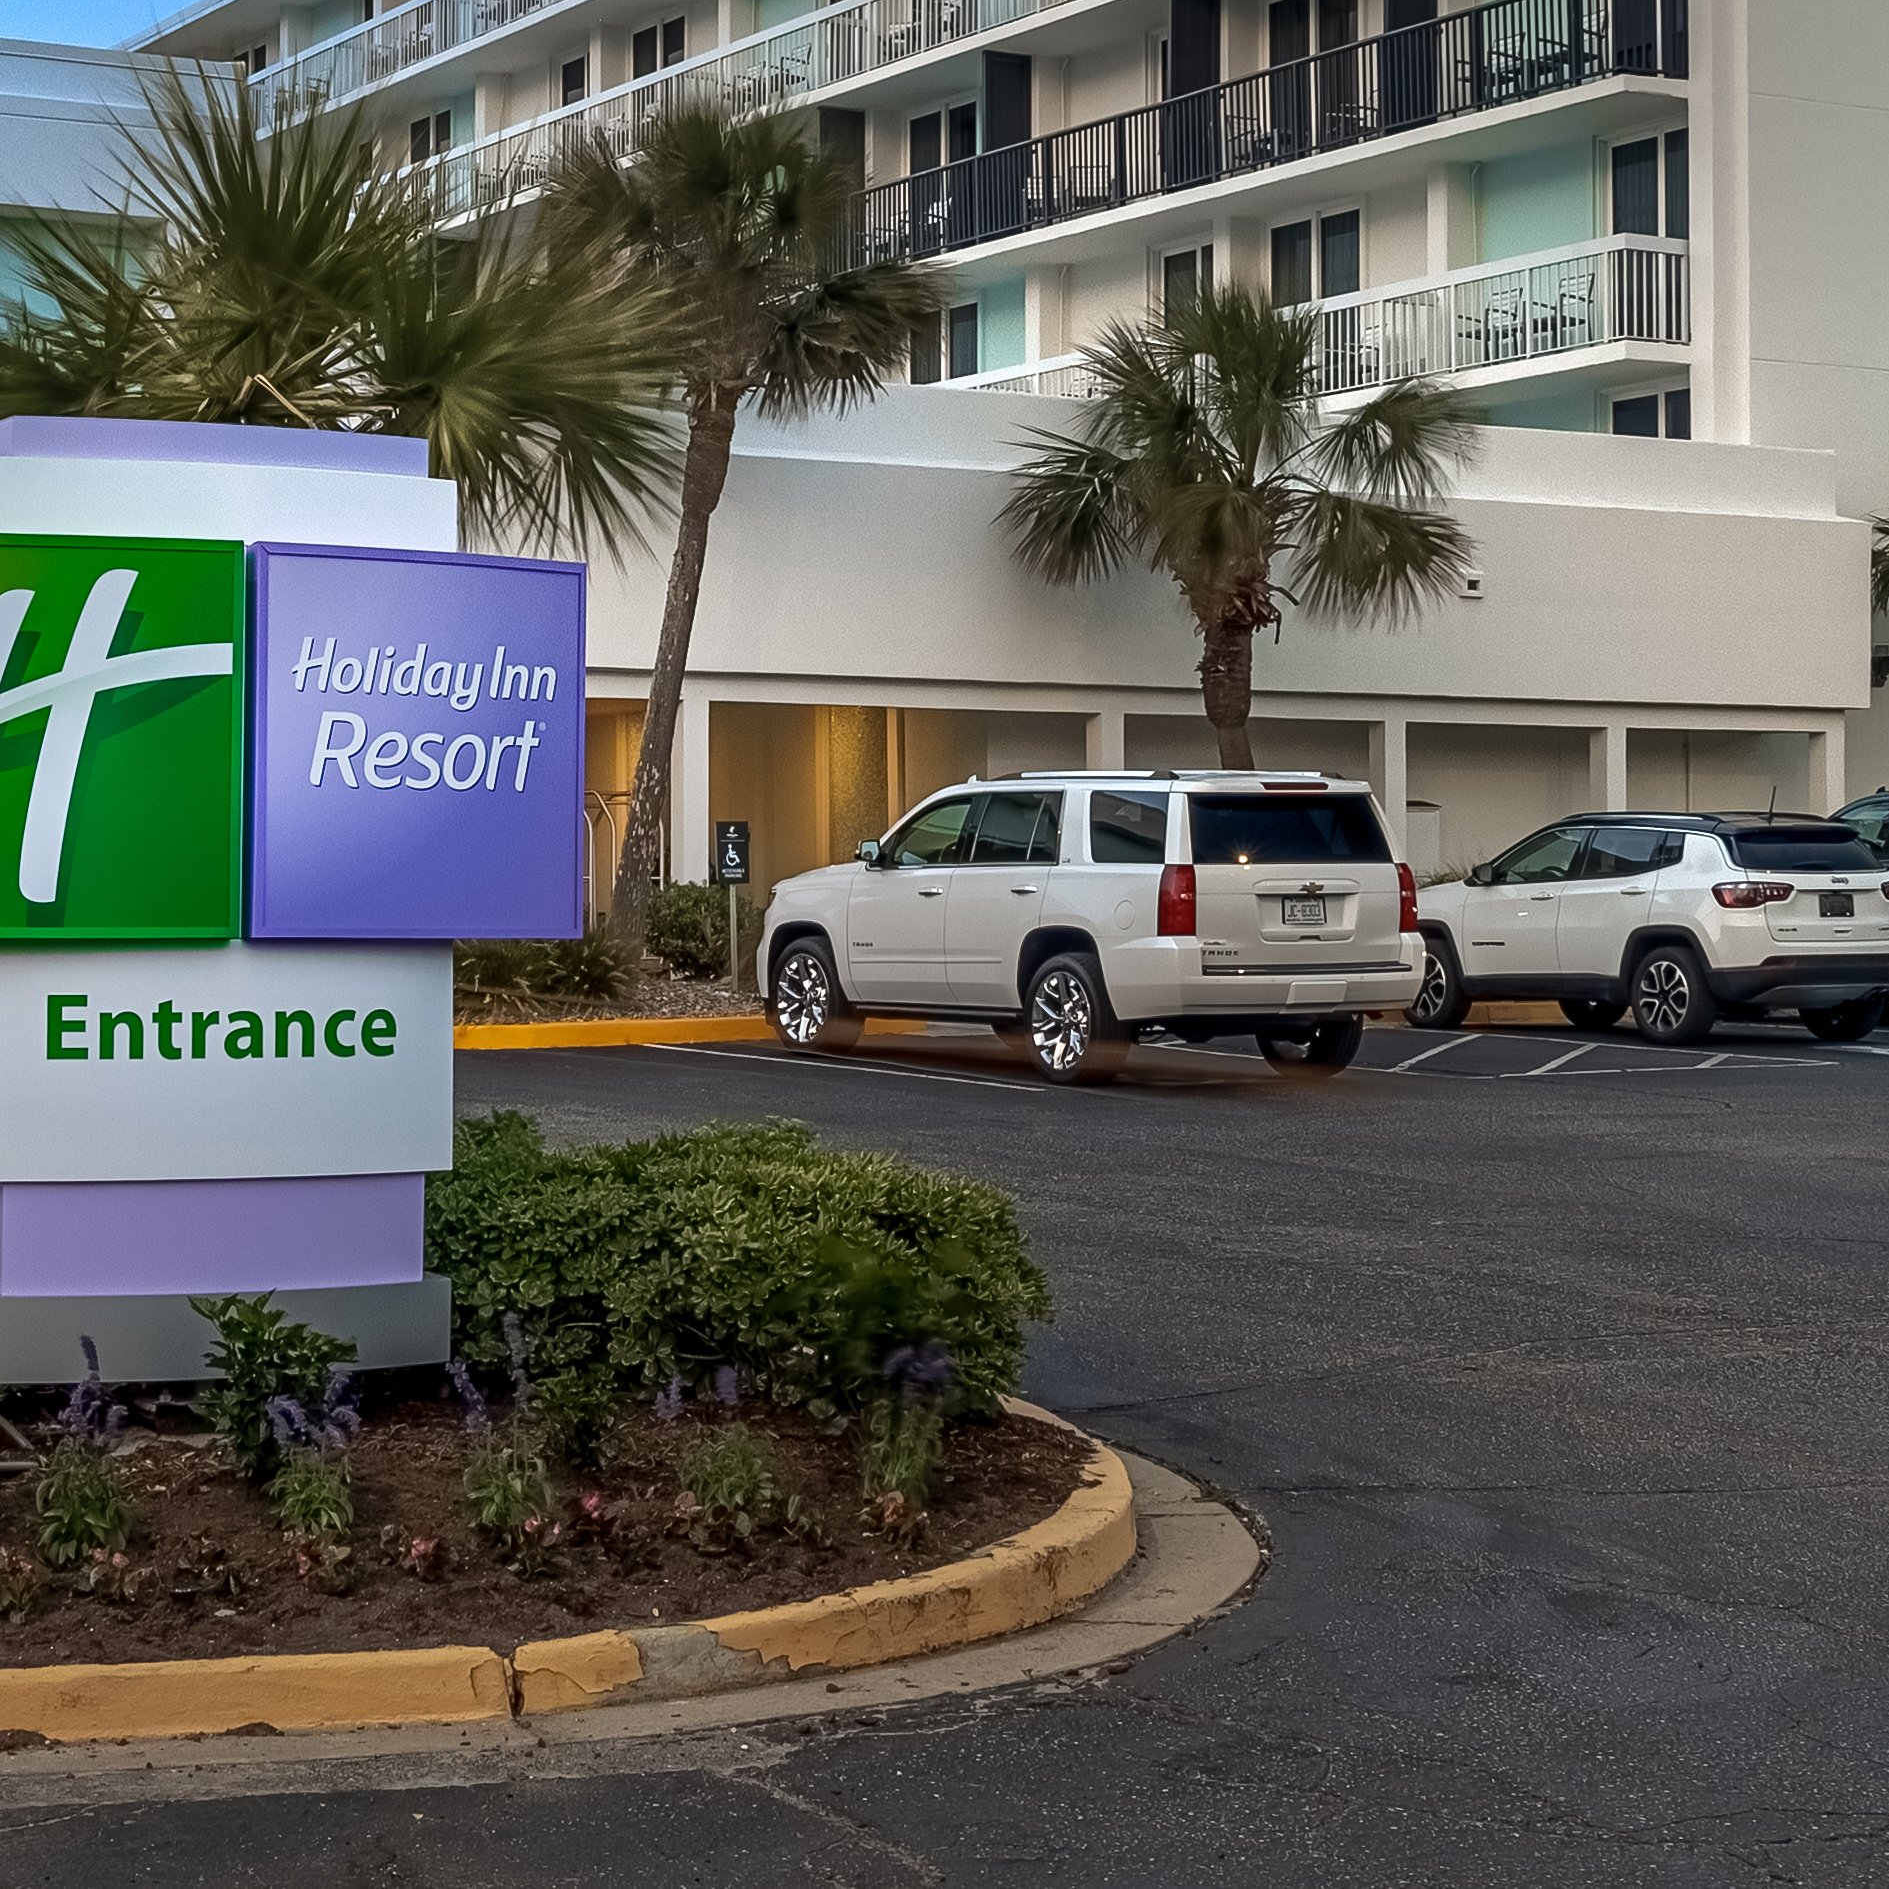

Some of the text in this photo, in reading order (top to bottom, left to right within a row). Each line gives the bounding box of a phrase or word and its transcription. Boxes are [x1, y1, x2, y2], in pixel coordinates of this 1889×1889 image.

[291, 636, 557, 712] Holiday Inn
[309, 710, 541, 793] Resort
[46, 994, 397, 1060] Entrance
